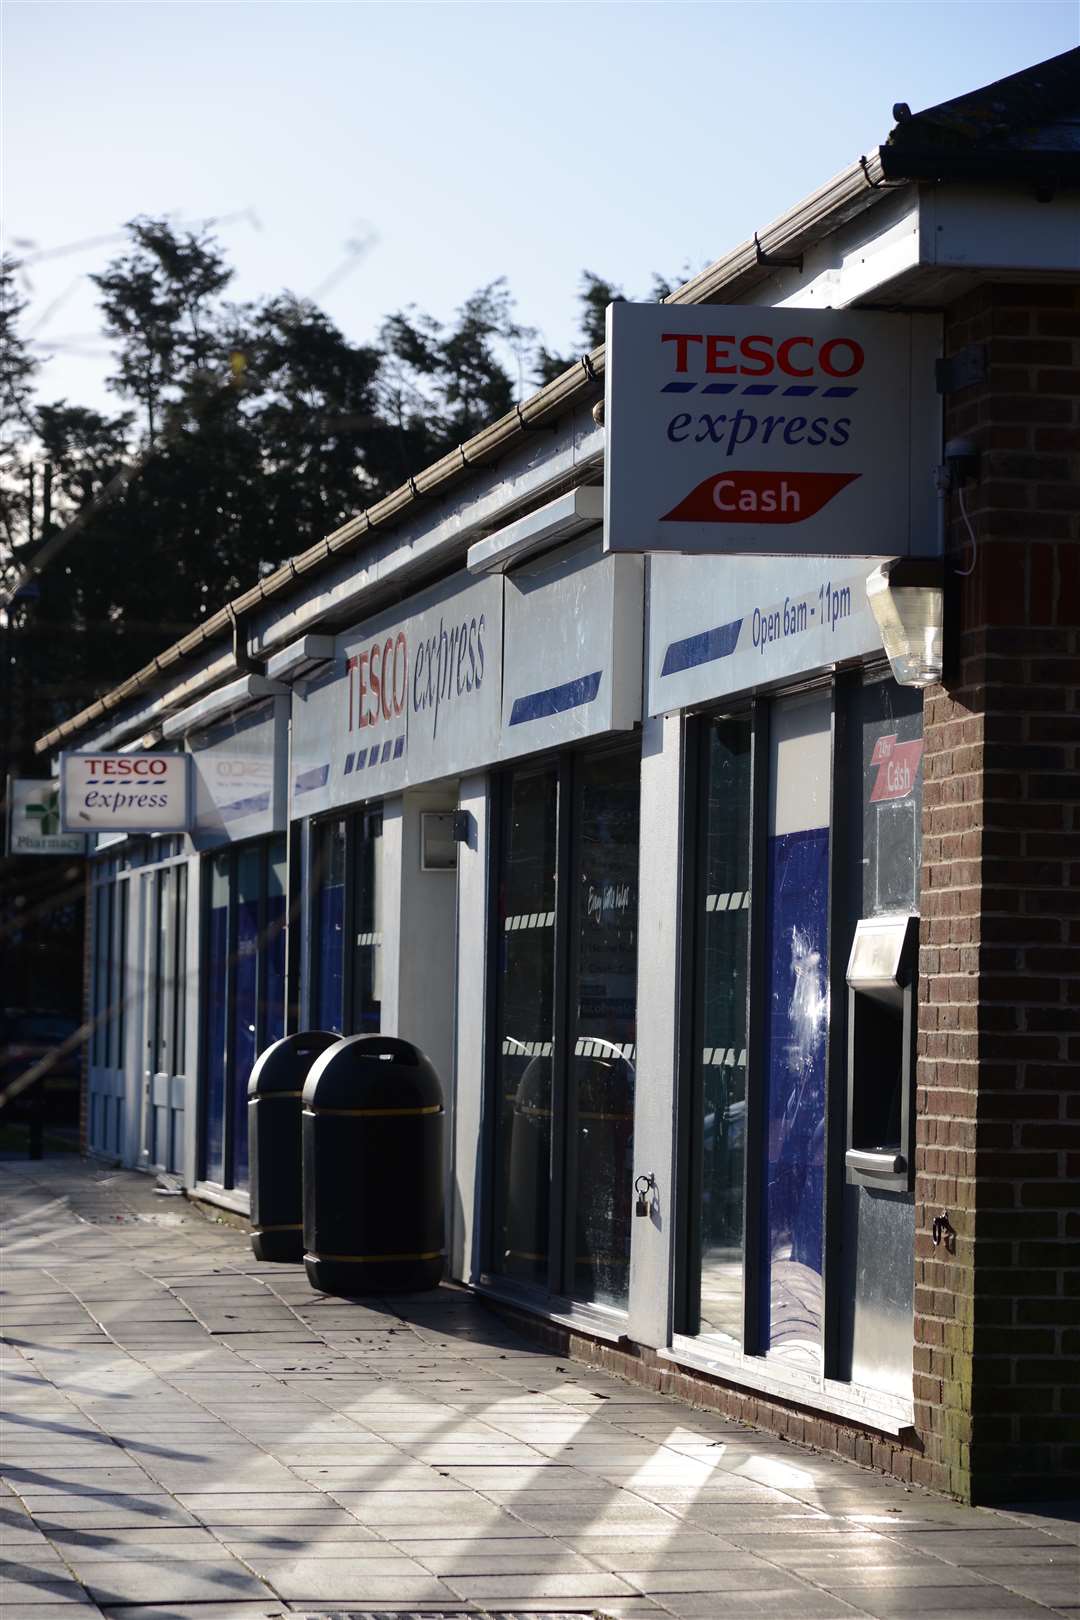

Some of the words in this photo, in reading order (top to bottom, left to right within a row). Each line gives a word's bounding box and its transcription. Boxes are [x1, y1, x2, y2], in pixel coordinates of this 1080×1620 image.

[661, 333, 865, 378] TESCO
[667, 409, 852, 456] express
[713, 480, 801, 512] Cash
[752, 607, 780, 654] Open
[783, 597, 807, 636] 6am
[819, 582, 851, 633] 11pm
[346, 631, 408, 732] TESCO
[413, 613, 486, 740] express
[85, 759, 167, 776] TESCO
[887, 758, 911, 792] Cash
[85, 789, 168, 812] express
[17, 836, 81, 851] Pharmacy
